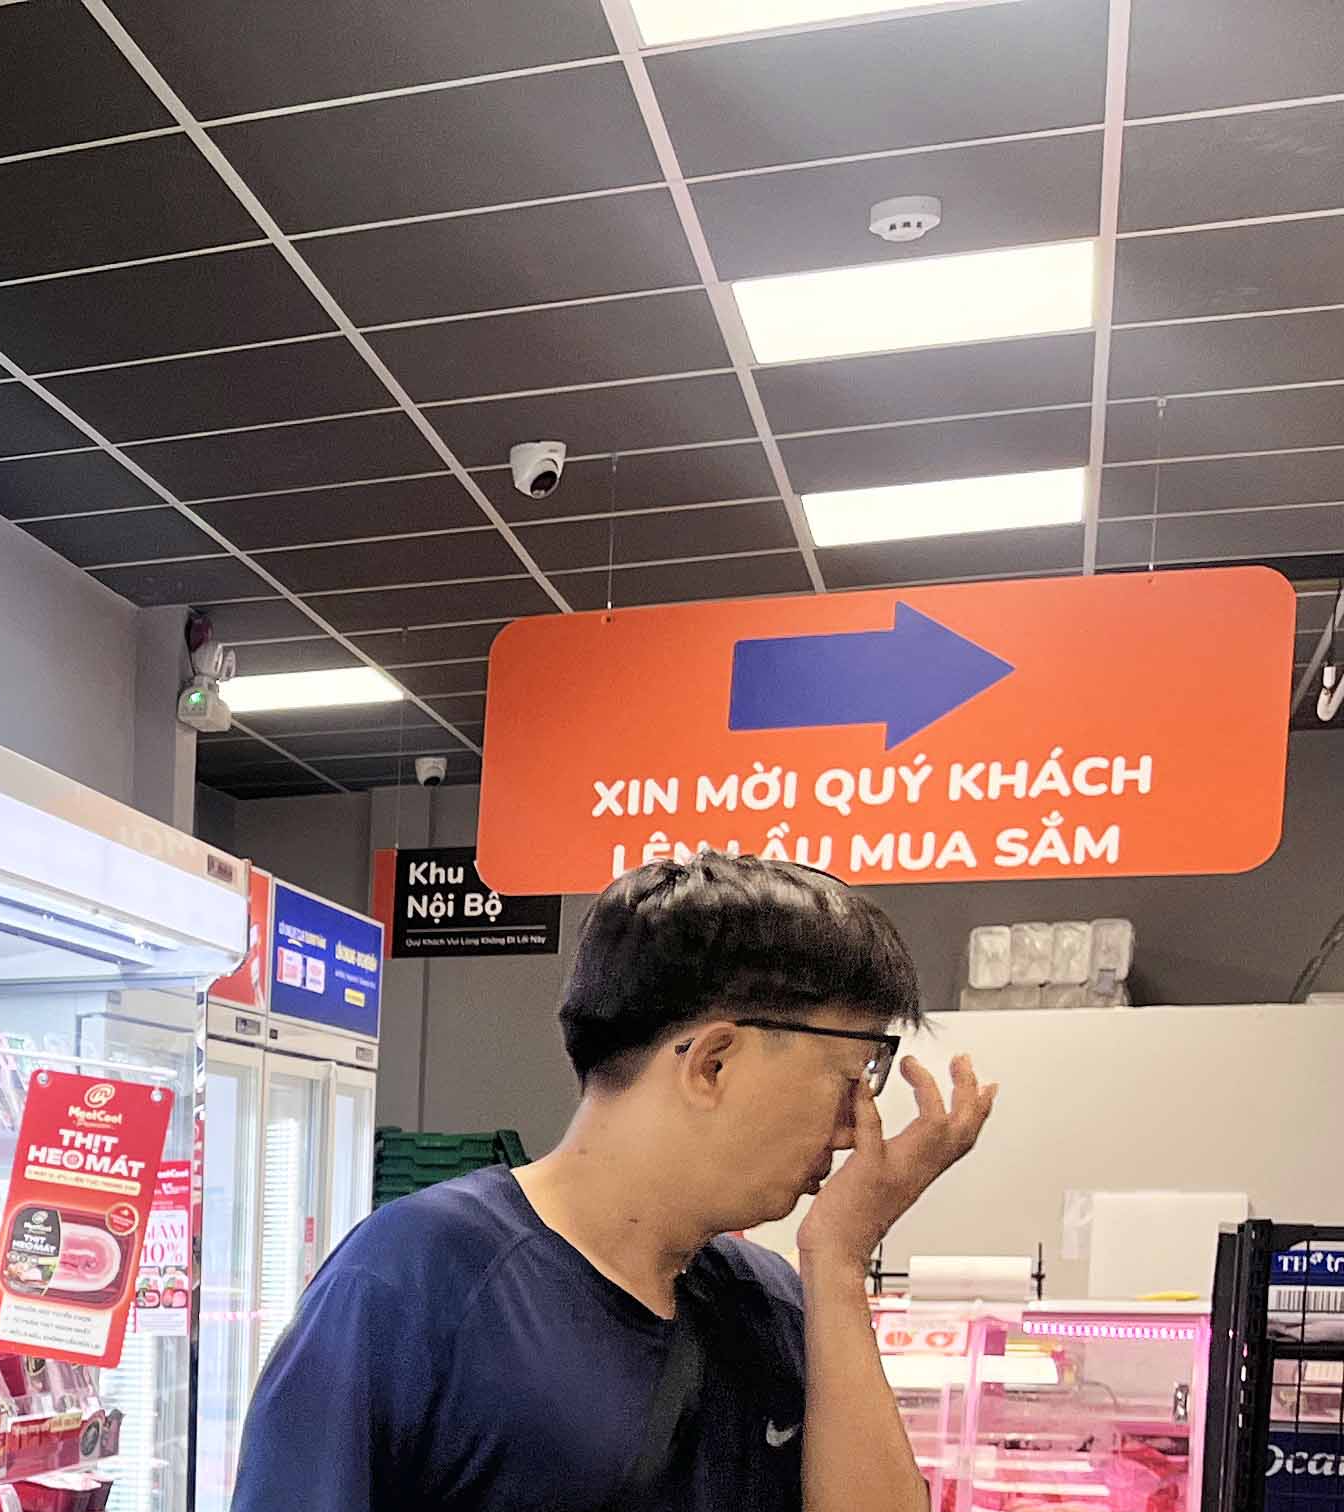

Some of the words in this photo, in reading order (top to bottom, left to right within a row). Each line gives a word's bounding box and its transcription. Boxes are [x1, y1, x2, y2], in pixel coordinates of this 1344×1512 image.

[591, 777, 679, 818] XIN
[695, 761, 798, 813] MỜI
[814, 752, 934, 817] QUÝ
[948, 746, 1153, 802] KHÁCH
[850, 831, 978, 872] MUA
[994, 810, 1120, 866] SẮM
[408, 861, 464, 886] Khu
[407, 893, 455, 924] Nội
[464, 891, 503, 923] Bộ
[58, 1128, 119, 1154] THỊT
[27, 1145, 84, 1170] HEO
[85, 1150, 146, 1178] MÁT
[1278, 1255, 1307, 1272] TH
